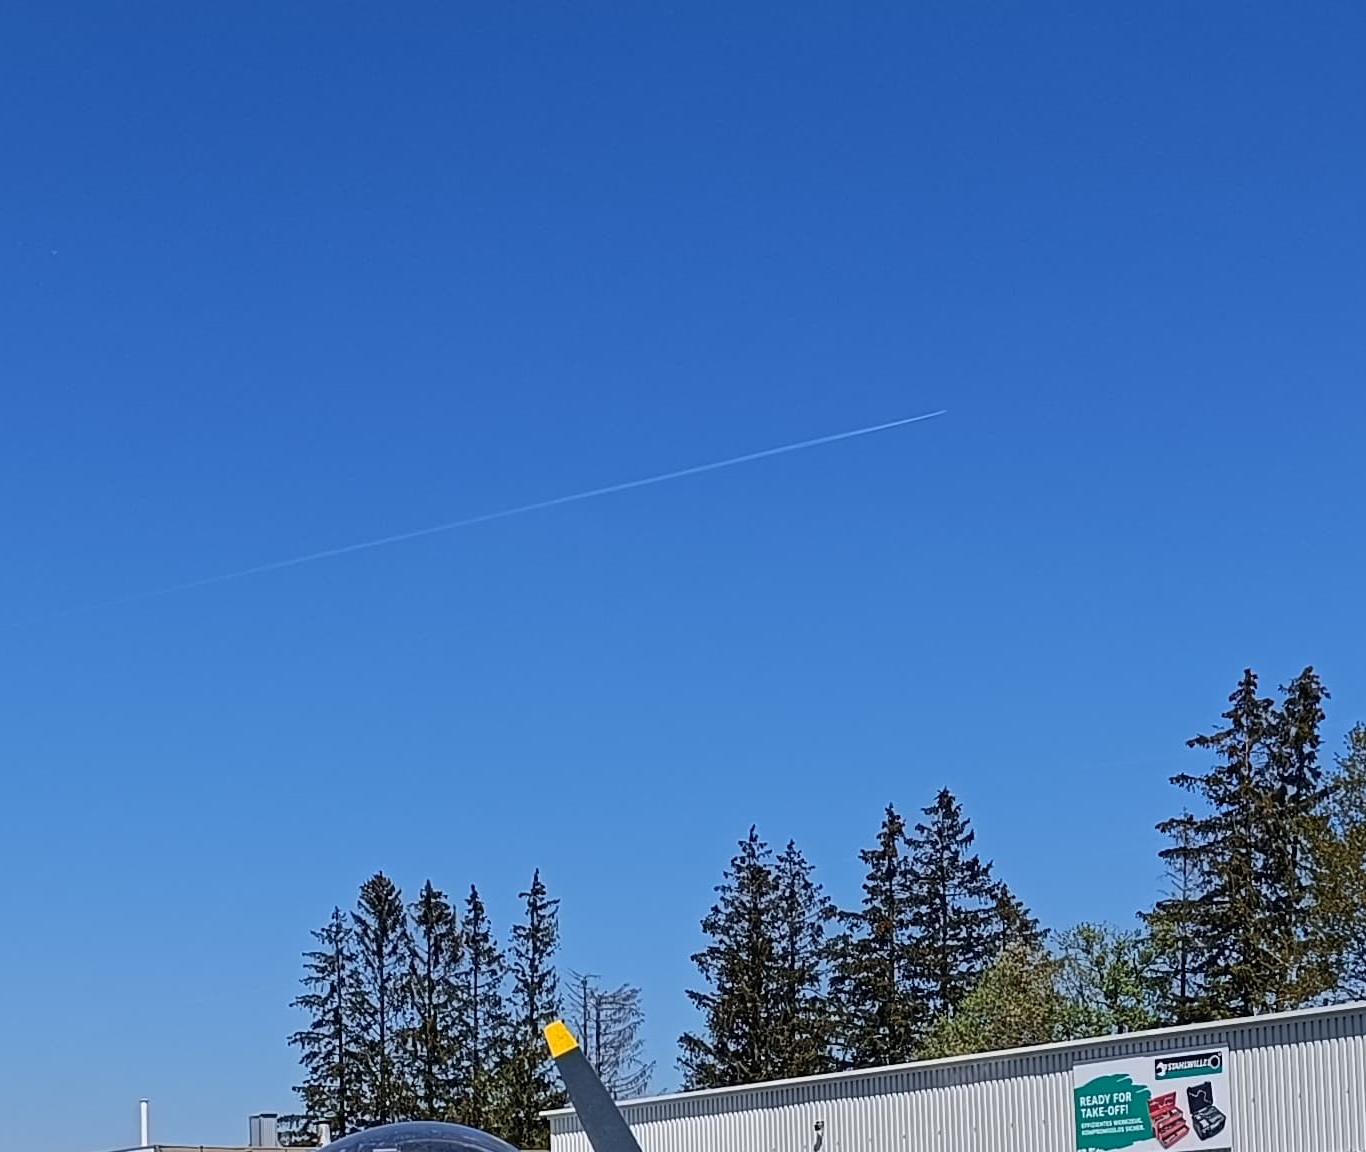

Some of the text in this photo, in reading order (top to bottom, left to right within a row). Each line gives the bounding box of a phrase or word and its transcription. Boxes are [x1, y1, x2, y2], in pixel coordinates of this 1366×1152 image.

[1079, 1091, 1132, 1107] READY FOR
[1081, 1105, 1129, 1119] TAKE-OFF!
